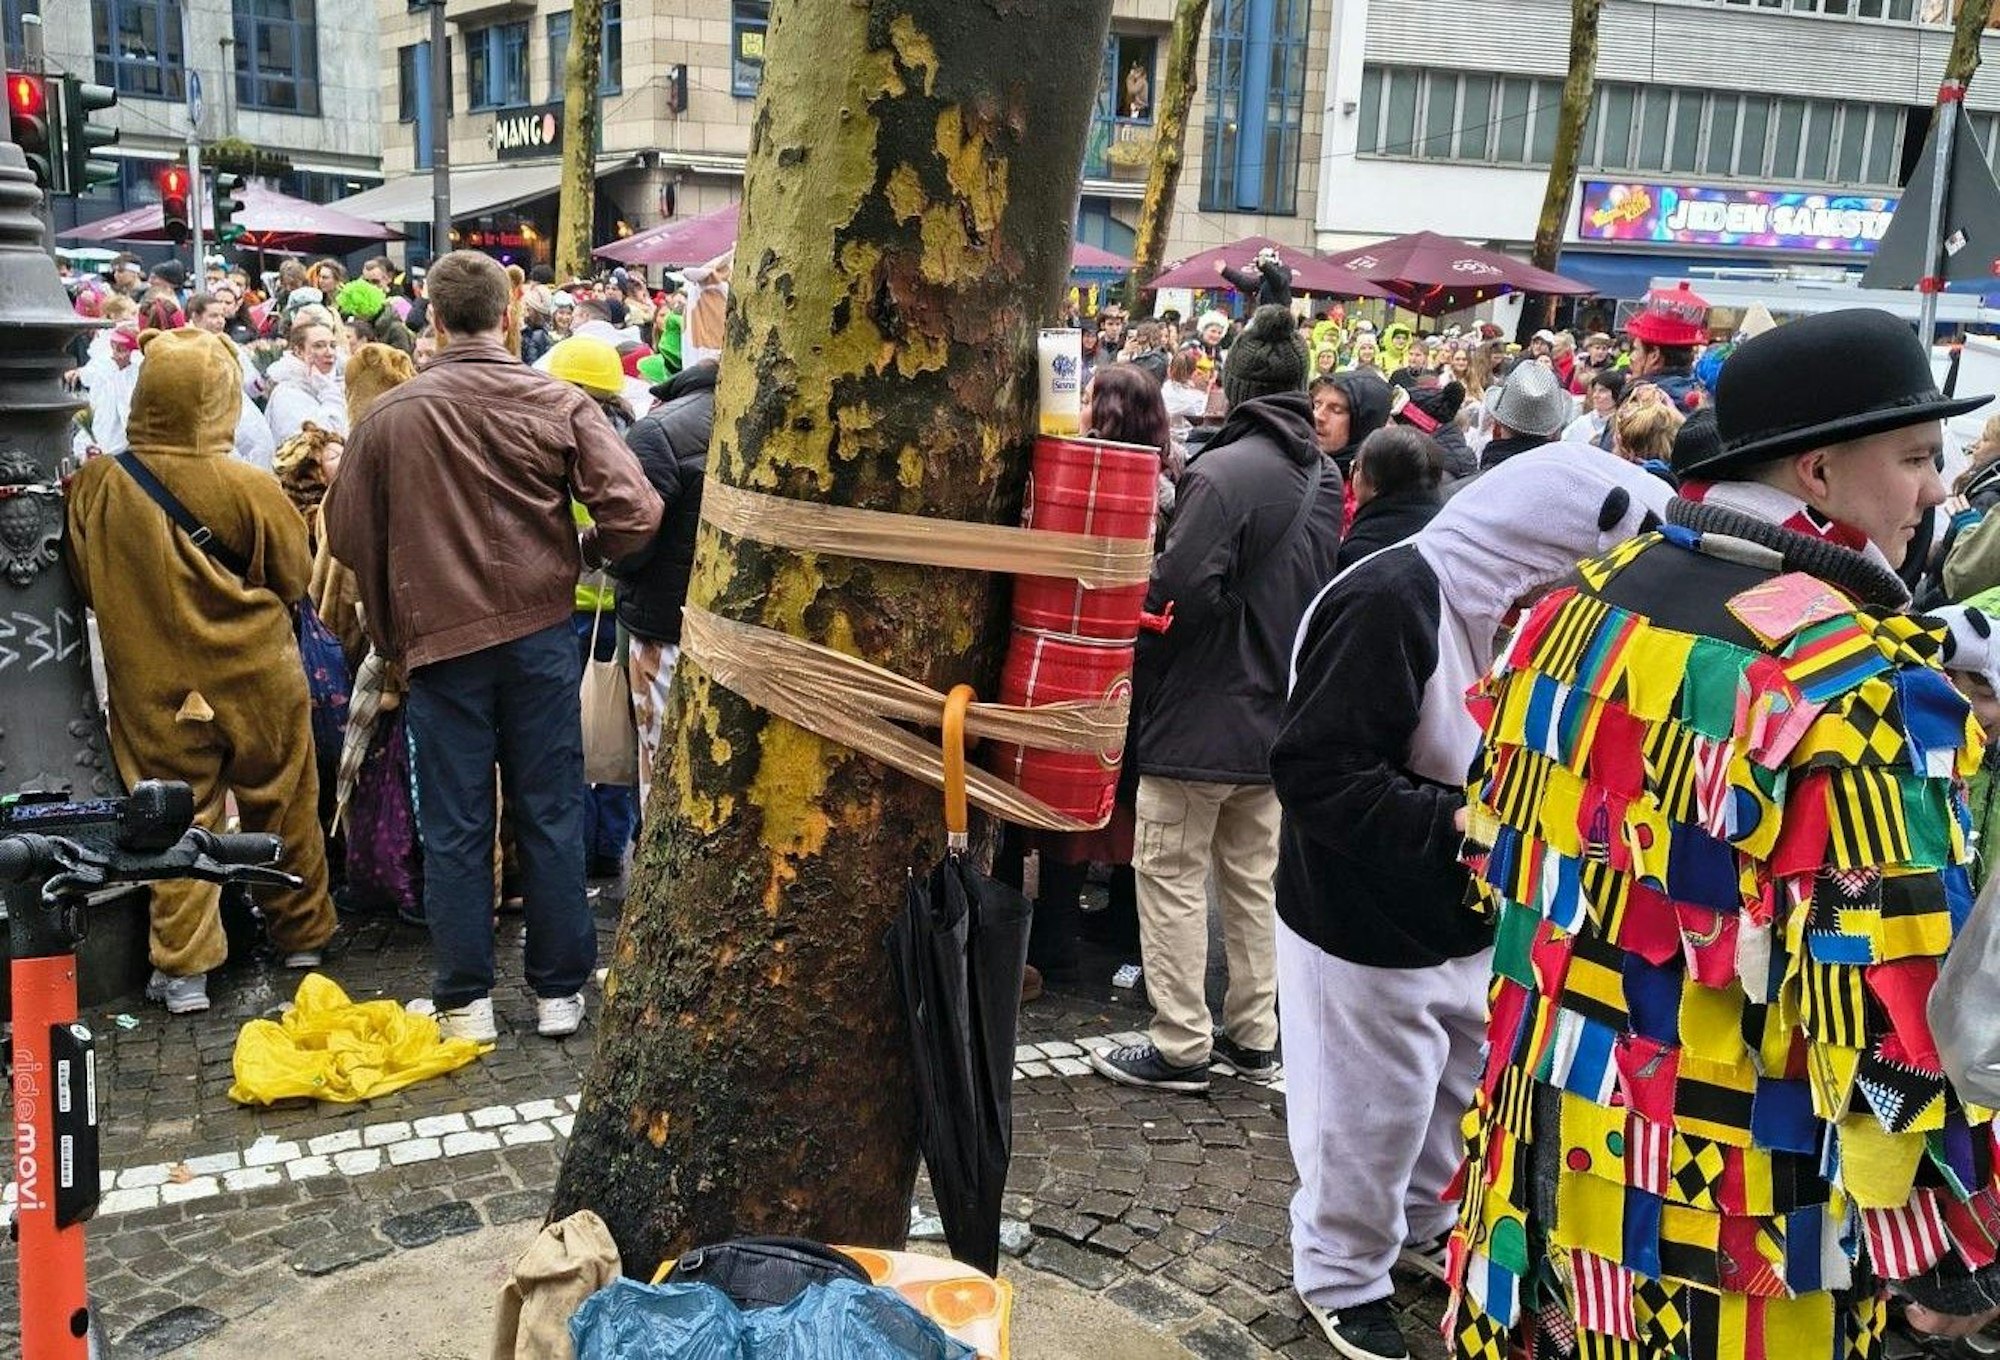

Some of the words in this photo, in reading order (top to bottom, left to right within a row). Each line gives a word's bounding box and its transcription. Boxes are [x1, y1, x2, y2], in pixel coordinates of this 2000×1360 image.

[497, 113, 556, 149] MANGO
[1667, 200, 1769, 234] JEDEN
[15, 1049, 47, 1210] ridemovi
